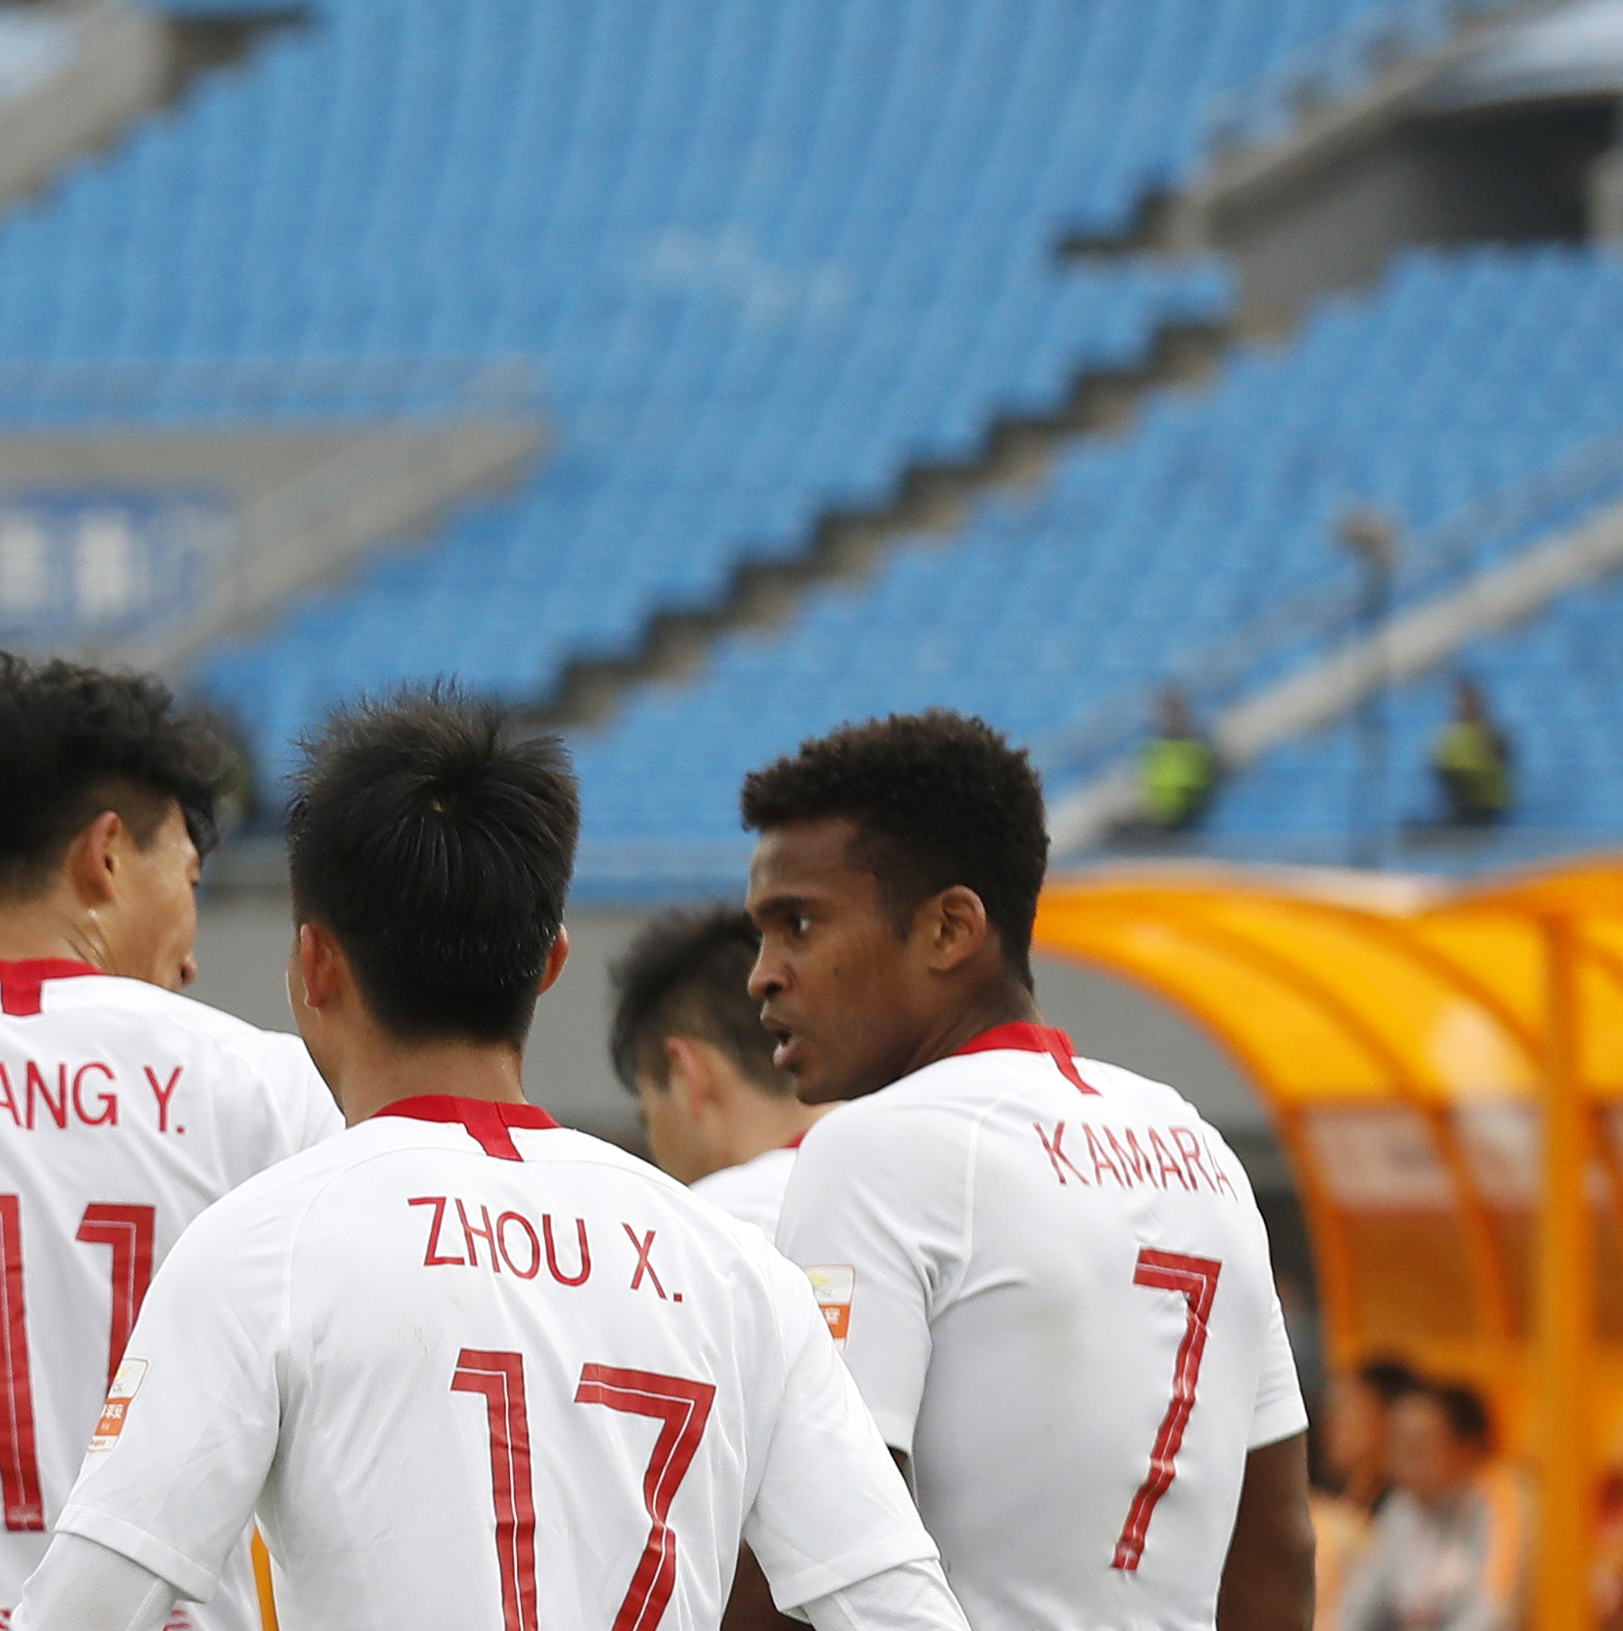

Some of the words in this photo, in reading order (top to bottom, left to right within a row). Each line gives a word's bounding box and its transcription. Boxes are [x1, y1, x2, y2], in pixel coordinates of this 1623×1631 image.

[143, 1065, 187, 1135] Y.
[1033, 1119, 1239, 1202] KAMARA
[407, 1196, 593, 1288] ZHOU
[621, 1221, 684, 1303] X.
[1111, 1246, 1223, 1572] 7
